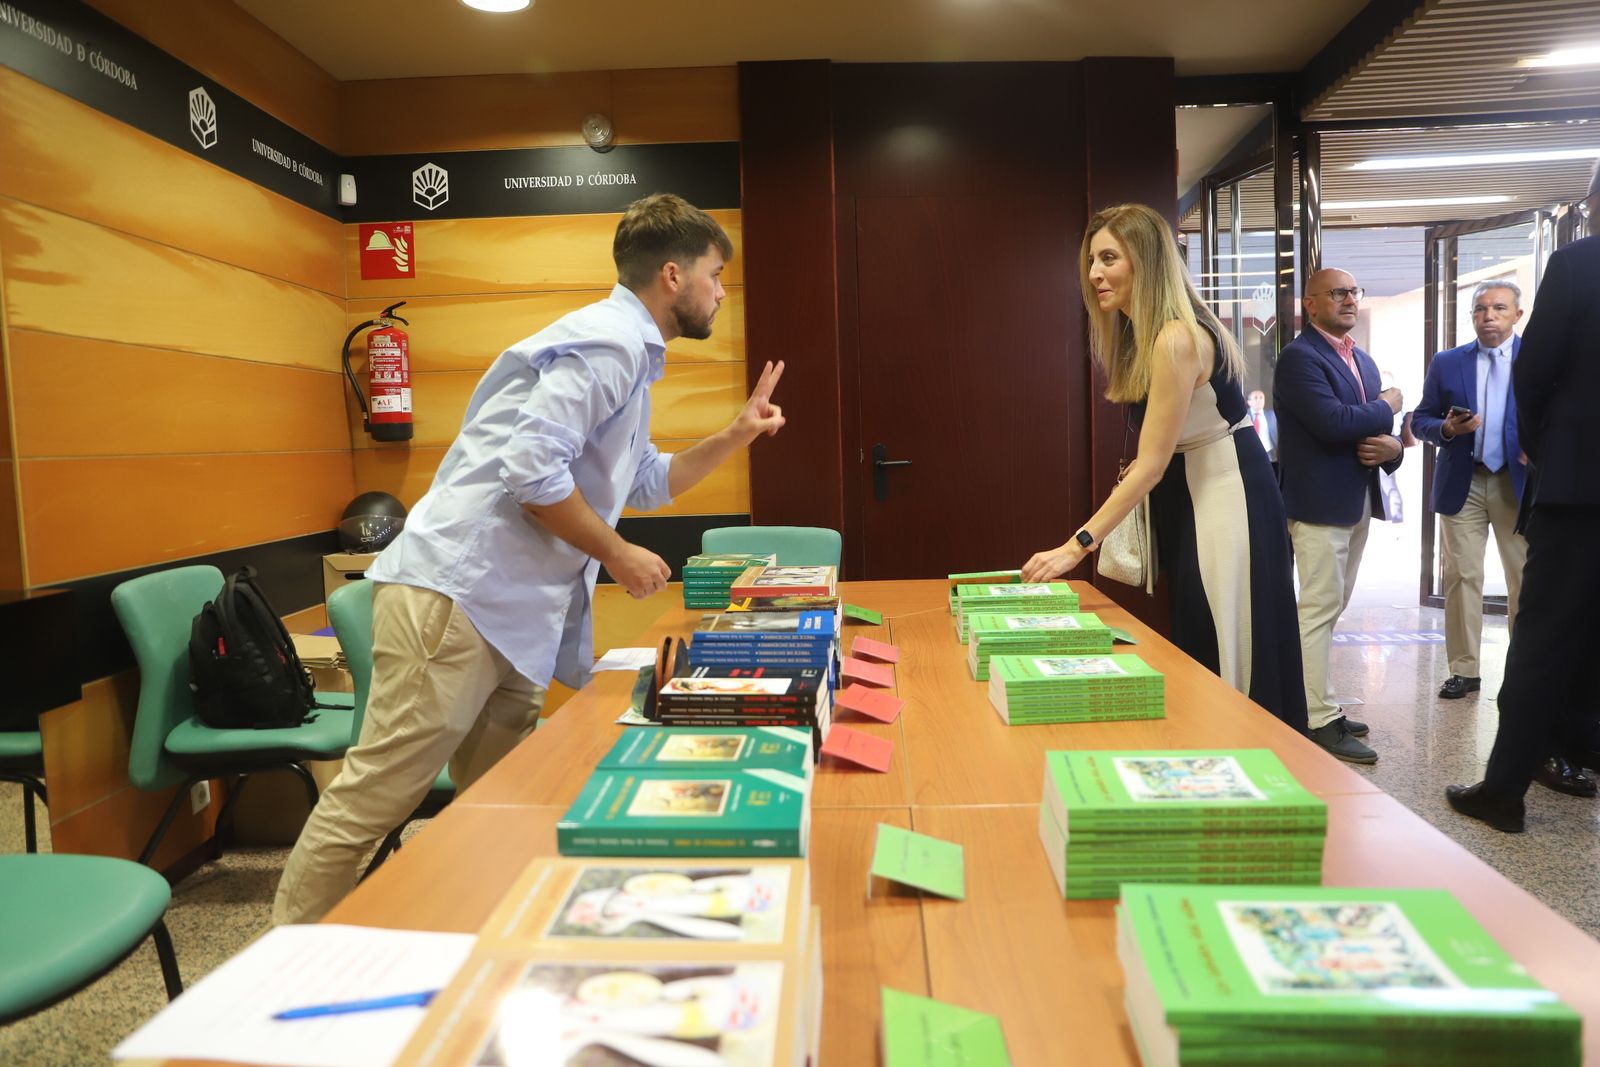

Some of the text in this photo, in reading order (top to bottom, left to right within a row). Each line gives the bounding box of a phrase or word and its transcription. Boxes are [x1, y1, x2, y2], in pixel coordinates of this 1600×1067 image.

[89, 50, 138, 90] CÓRDOBA
[252, 138, 291, 169] UNIVERSIDAD
[298, 162, 324, 186] CÓRDOBA
[504, 175, 572, 189] UNIVERSIDAD
[588, 171, 637, 186] CÓRDOBA
